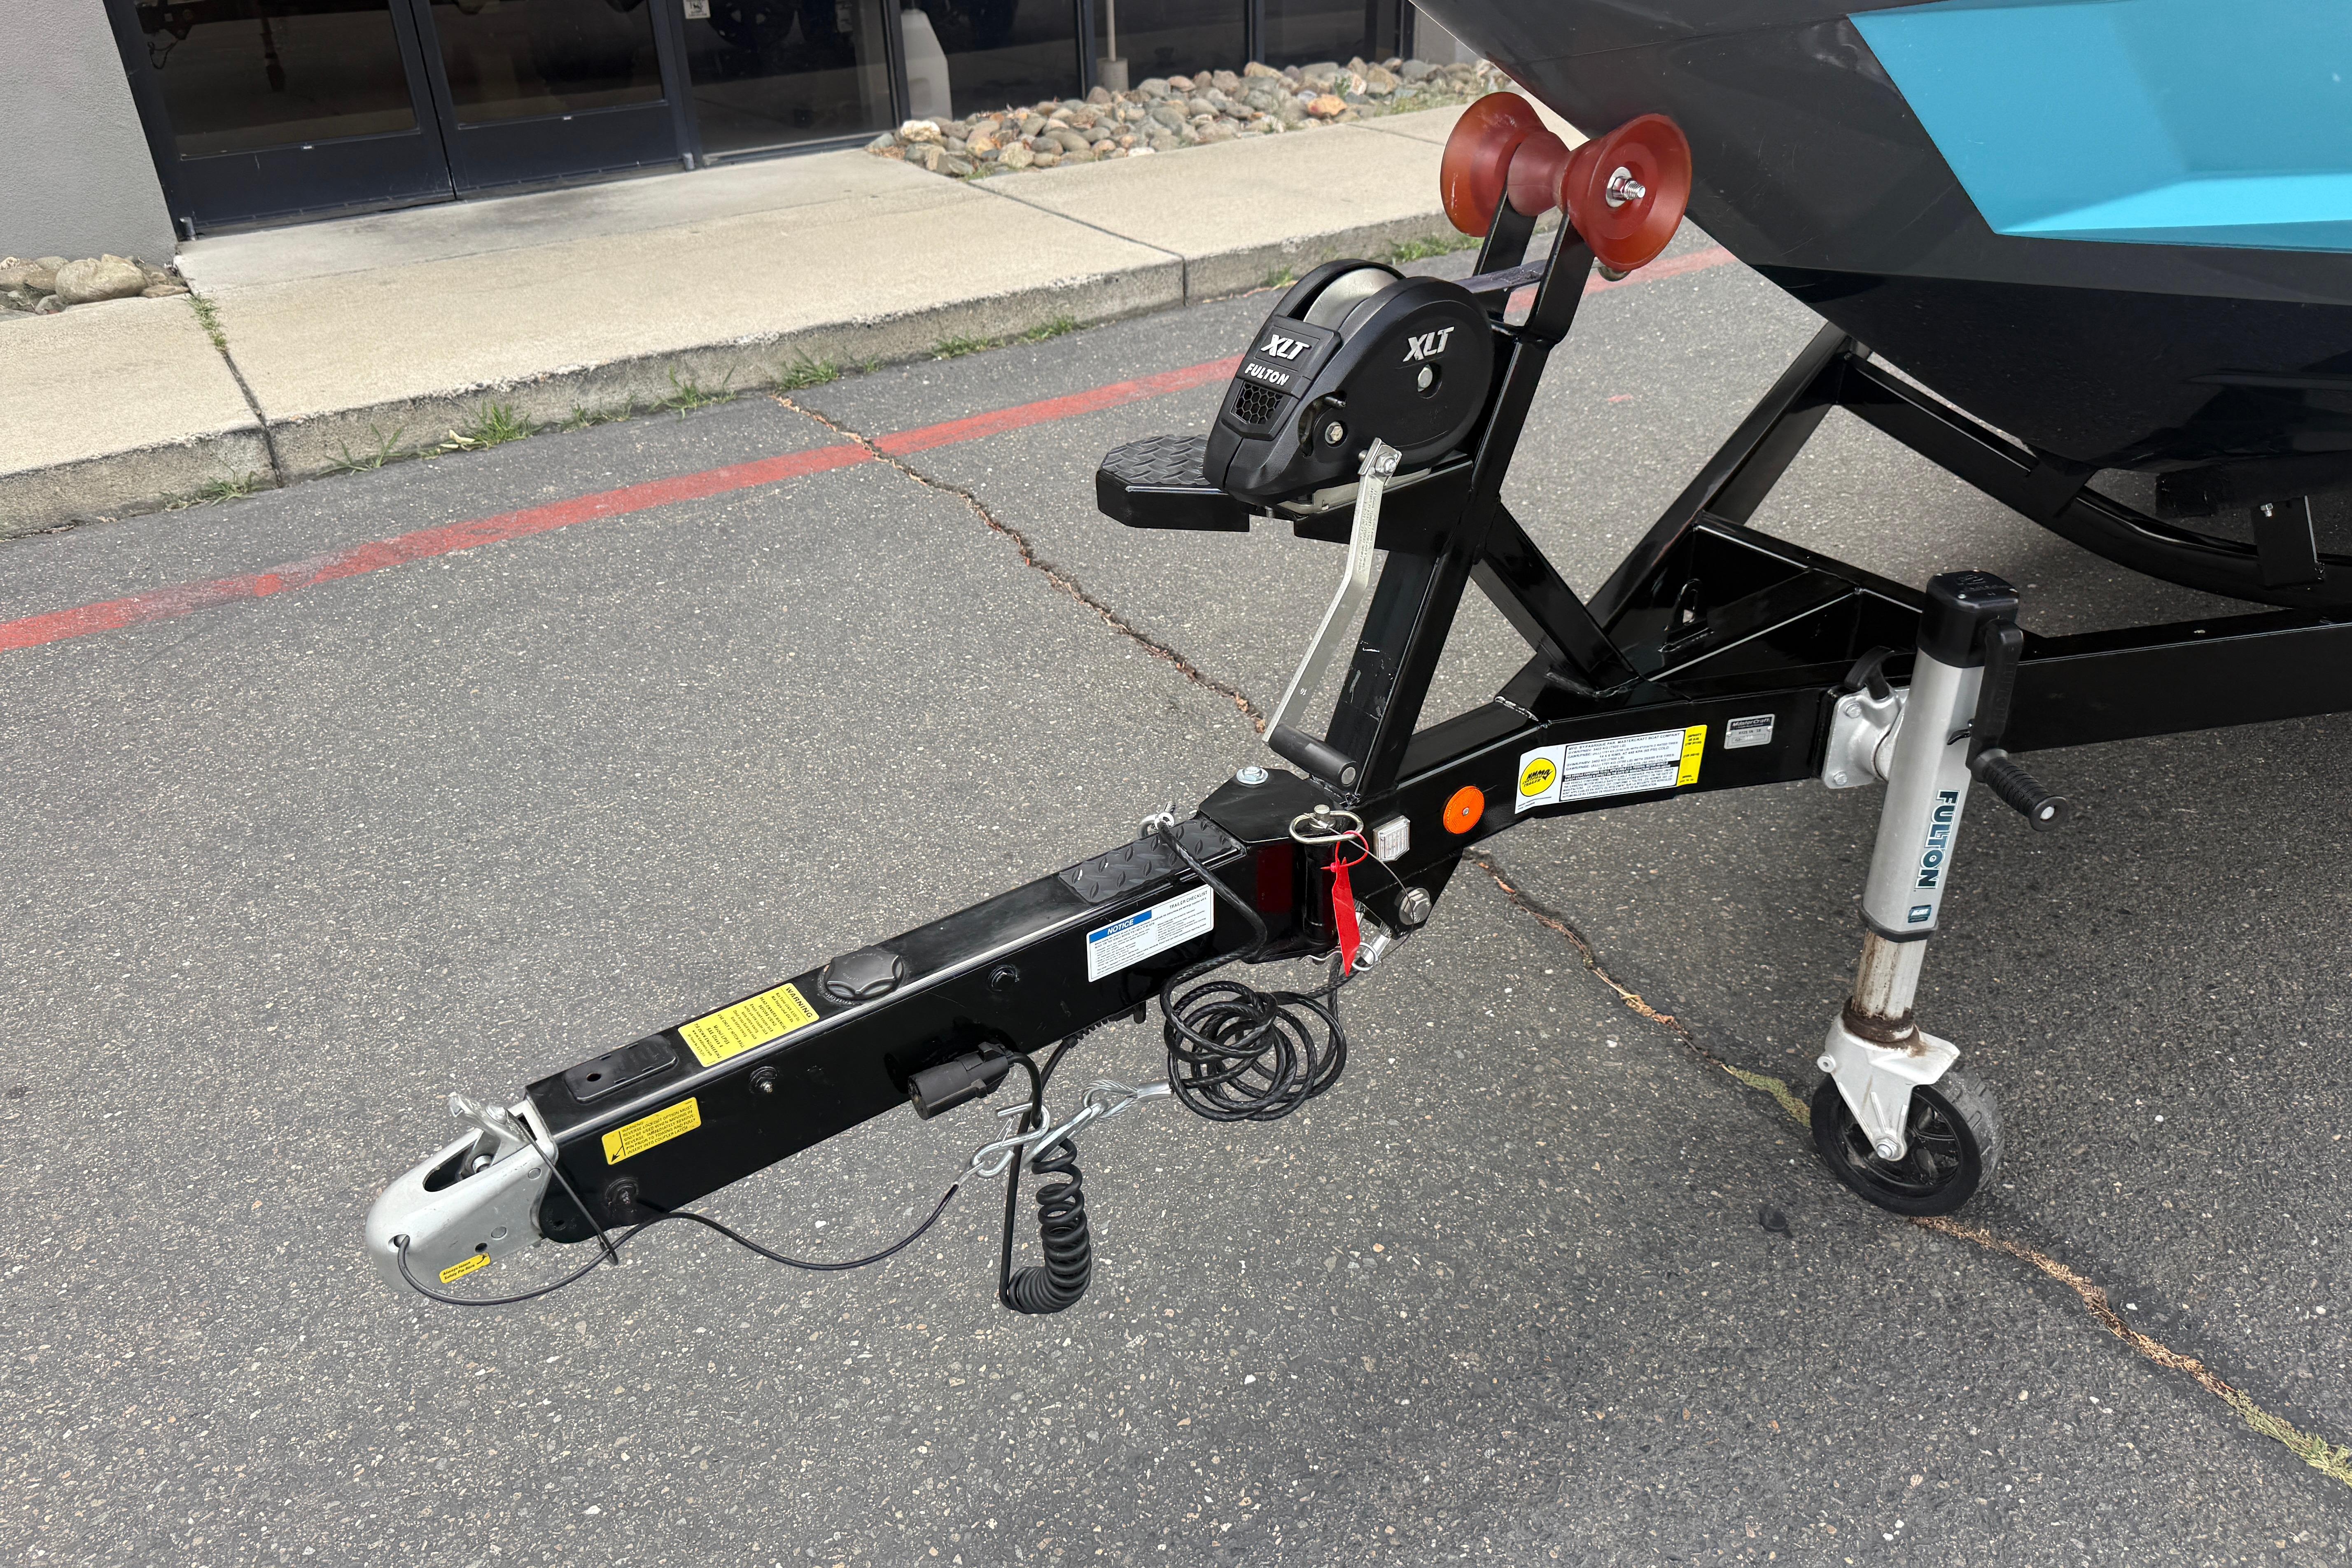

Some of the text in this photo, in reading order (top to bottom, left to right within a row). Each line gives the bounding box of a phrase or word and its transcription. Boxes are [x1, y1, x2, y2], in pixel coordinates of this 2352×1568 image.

[1260, 334, 1310, 360] XLT
[1402, 326, 1454, 362] XLT
[1244, 363, 1290, 386] FULTON
[1732, 718, 1770, 726] MasterCraft
[1916, 789, 1960, 889] FULTON
[1169, 890, 1208, 909] TRAILER CHECKLIST
[1107, 918, 1134, 935] NOTICE
[785, 987, 813, 1018] WARNING
[711, 1034, 721, 1045] Class
[713, 1024, 723, 1036] Model
[642, 1117, 663, 1129] LOCKOUT
[663, 1110, 679, 1120] OPTION
[654, 1131, 674, 1143] COUPLER
[655, 1127, 672, 1138] TOWING
